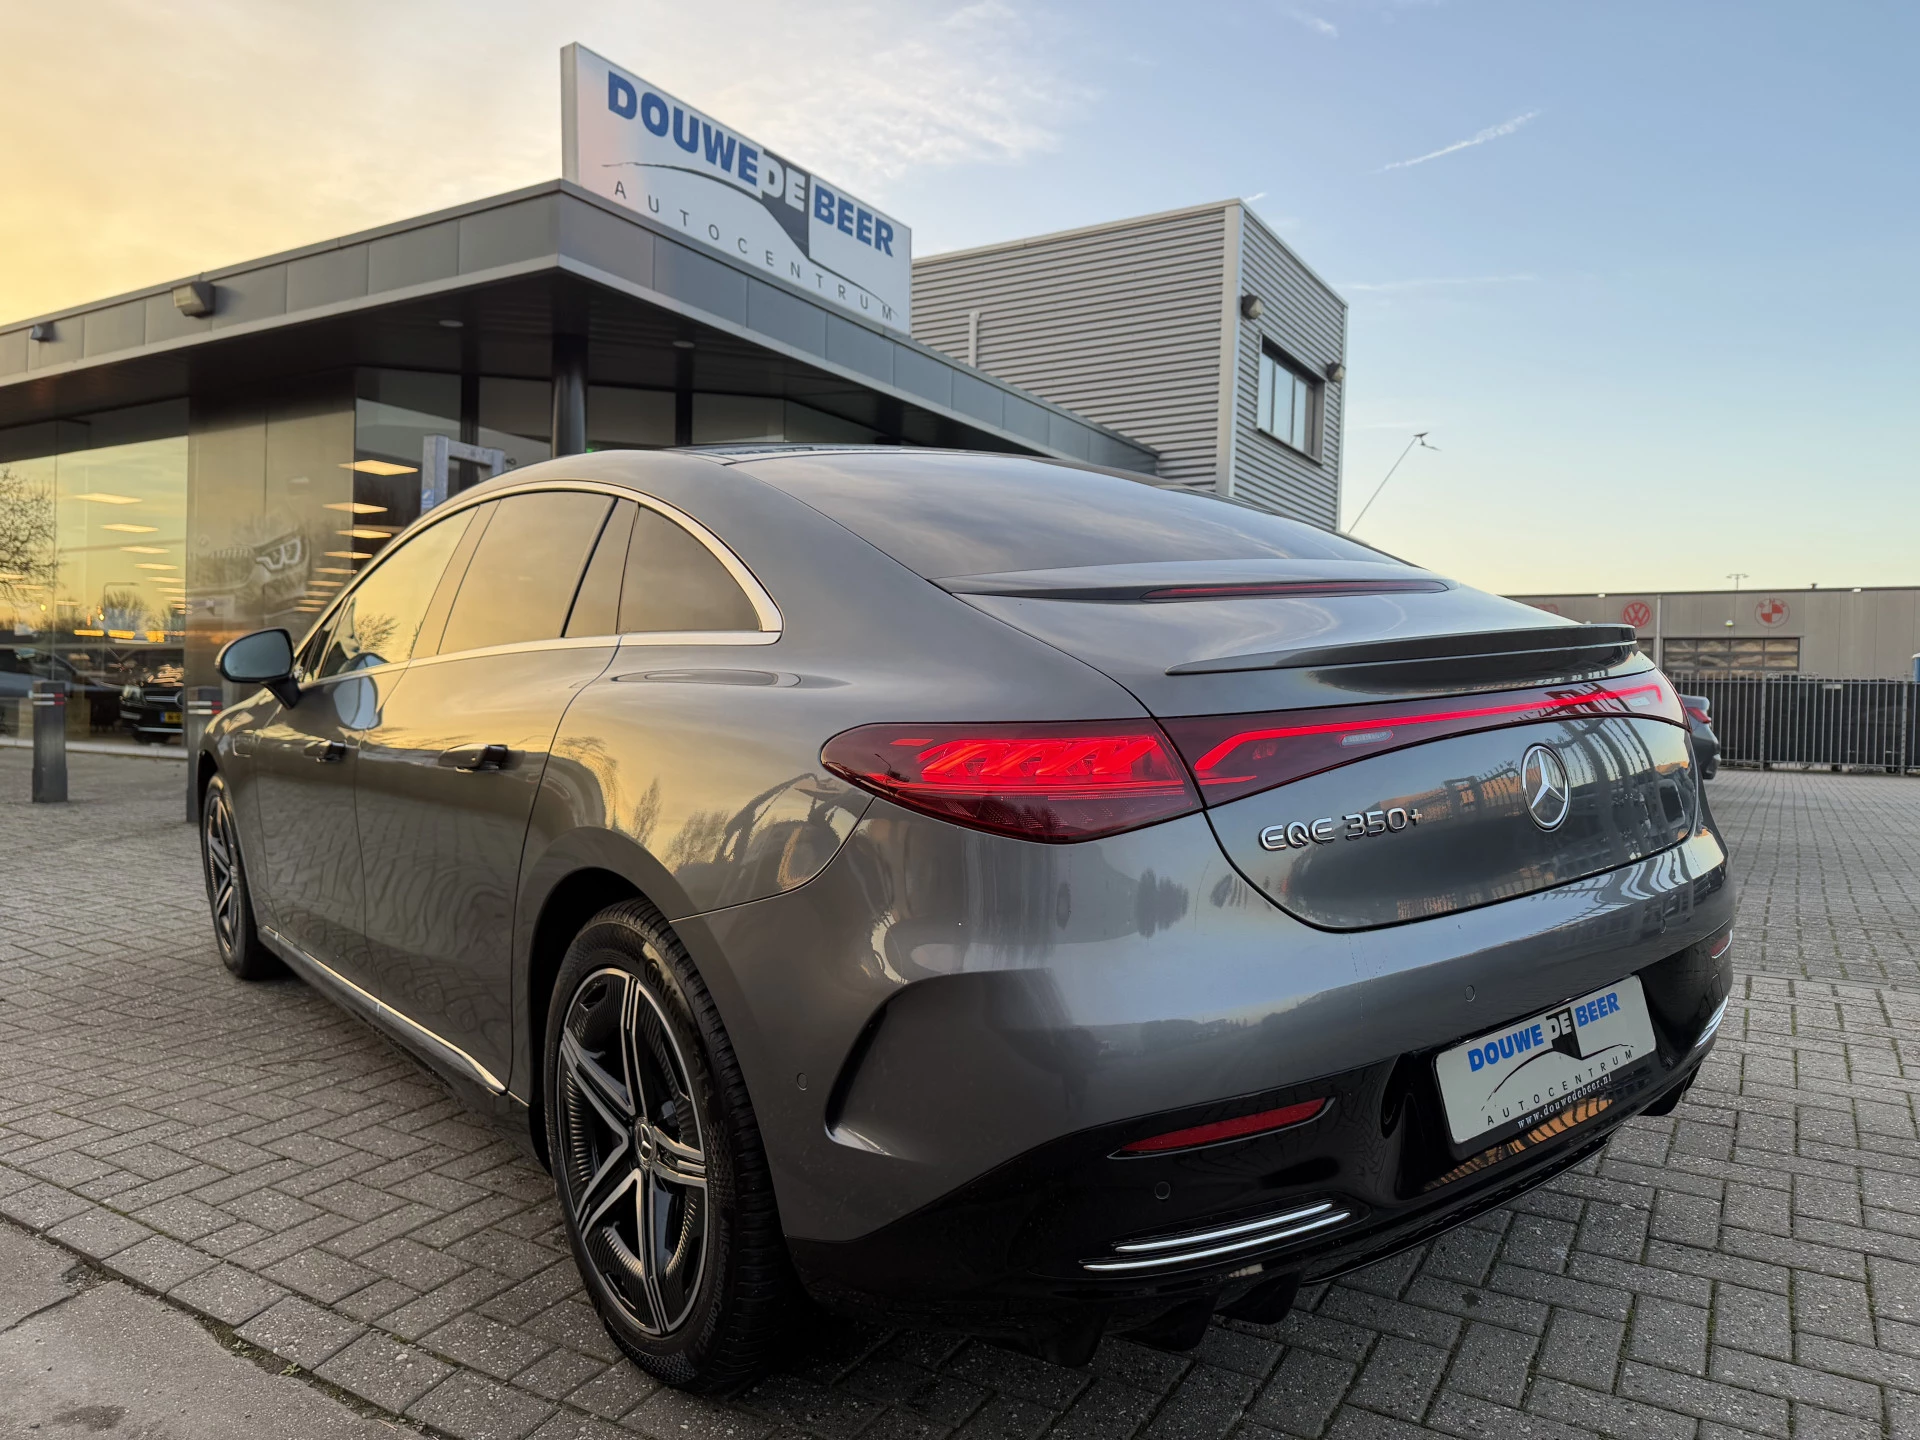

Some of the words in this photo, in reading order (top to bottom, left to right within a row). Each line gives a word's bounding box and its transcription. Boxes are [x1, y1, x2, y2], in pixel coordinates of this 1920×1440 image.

[608, 70, 758, 187] DOUWE
[761, 153, 806, 213] DE
[814, 184, 894, 258] BEER
[614, 180, 892, 321] AUTOCENTRUM
[1259, 816, 1336, 851] EQE
[1342, 806, 1423, 841] 350+
[1467, 1023, 1544, 1072] DOUWE
[1549, 1011, 1572, 1041] DE
[1574, 992, 1621, 1028] BEER
[1487, 1050, 1633, 1126] AUTOCENTRUM
[1518, 1073, 1612, 1129] www.douwedebeer.nl
